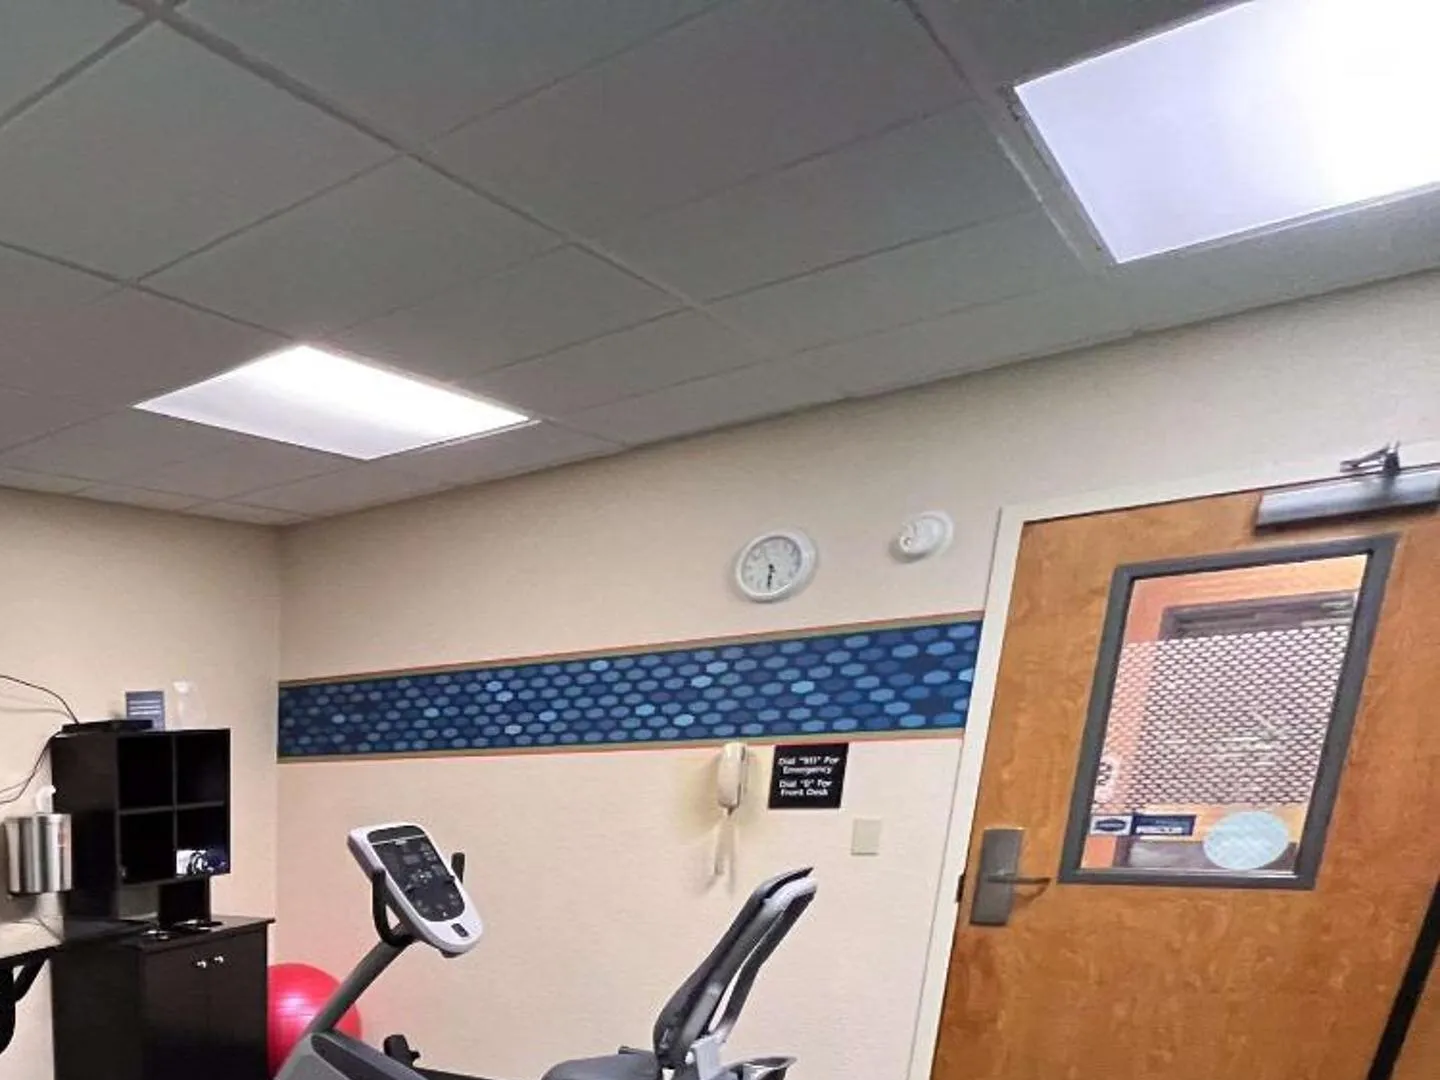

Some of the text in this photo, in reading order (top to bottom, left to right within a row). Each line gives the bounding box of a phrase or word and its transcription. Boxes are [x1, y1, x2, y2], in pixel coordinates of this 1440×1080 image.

[778, 756, 796, 766] Dial
[823, 755, 841, 765] For
[782, 766, 833, 776] Emergency
[779, 779, 797, 788] Dial
[817, 779, 833, 788] For
[780, 788, 829, 797] Front Desk
